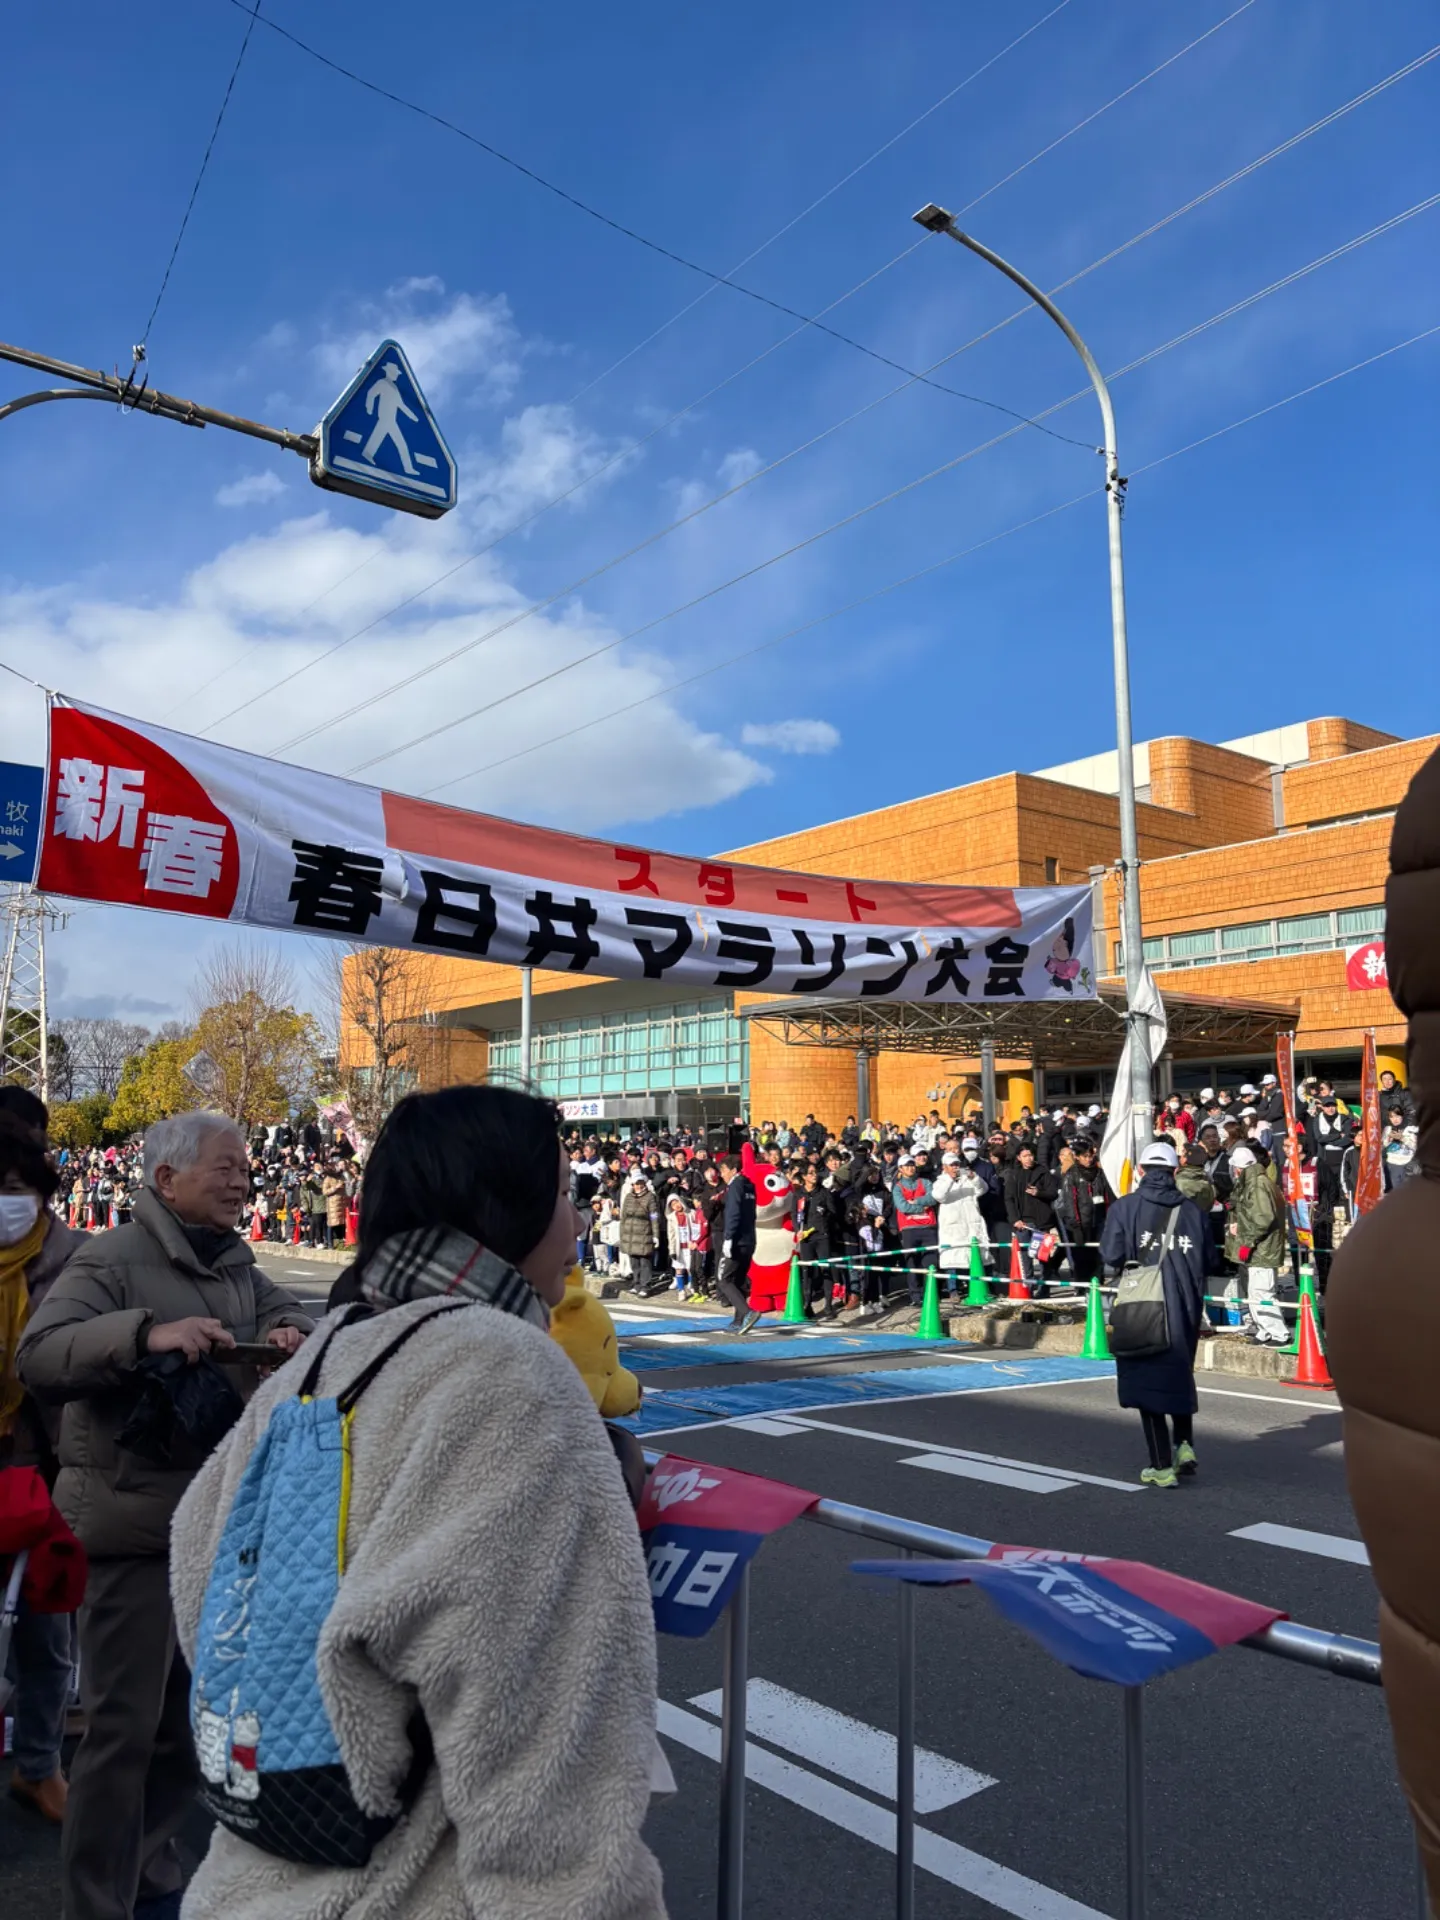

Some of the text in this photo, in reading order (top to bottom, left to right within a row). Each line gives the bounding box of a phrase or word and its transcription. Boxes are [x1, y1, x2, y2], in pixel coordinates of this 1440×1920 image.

[52, 756, 227, 898] 新春
[614, 848, 877, 922] スタート
